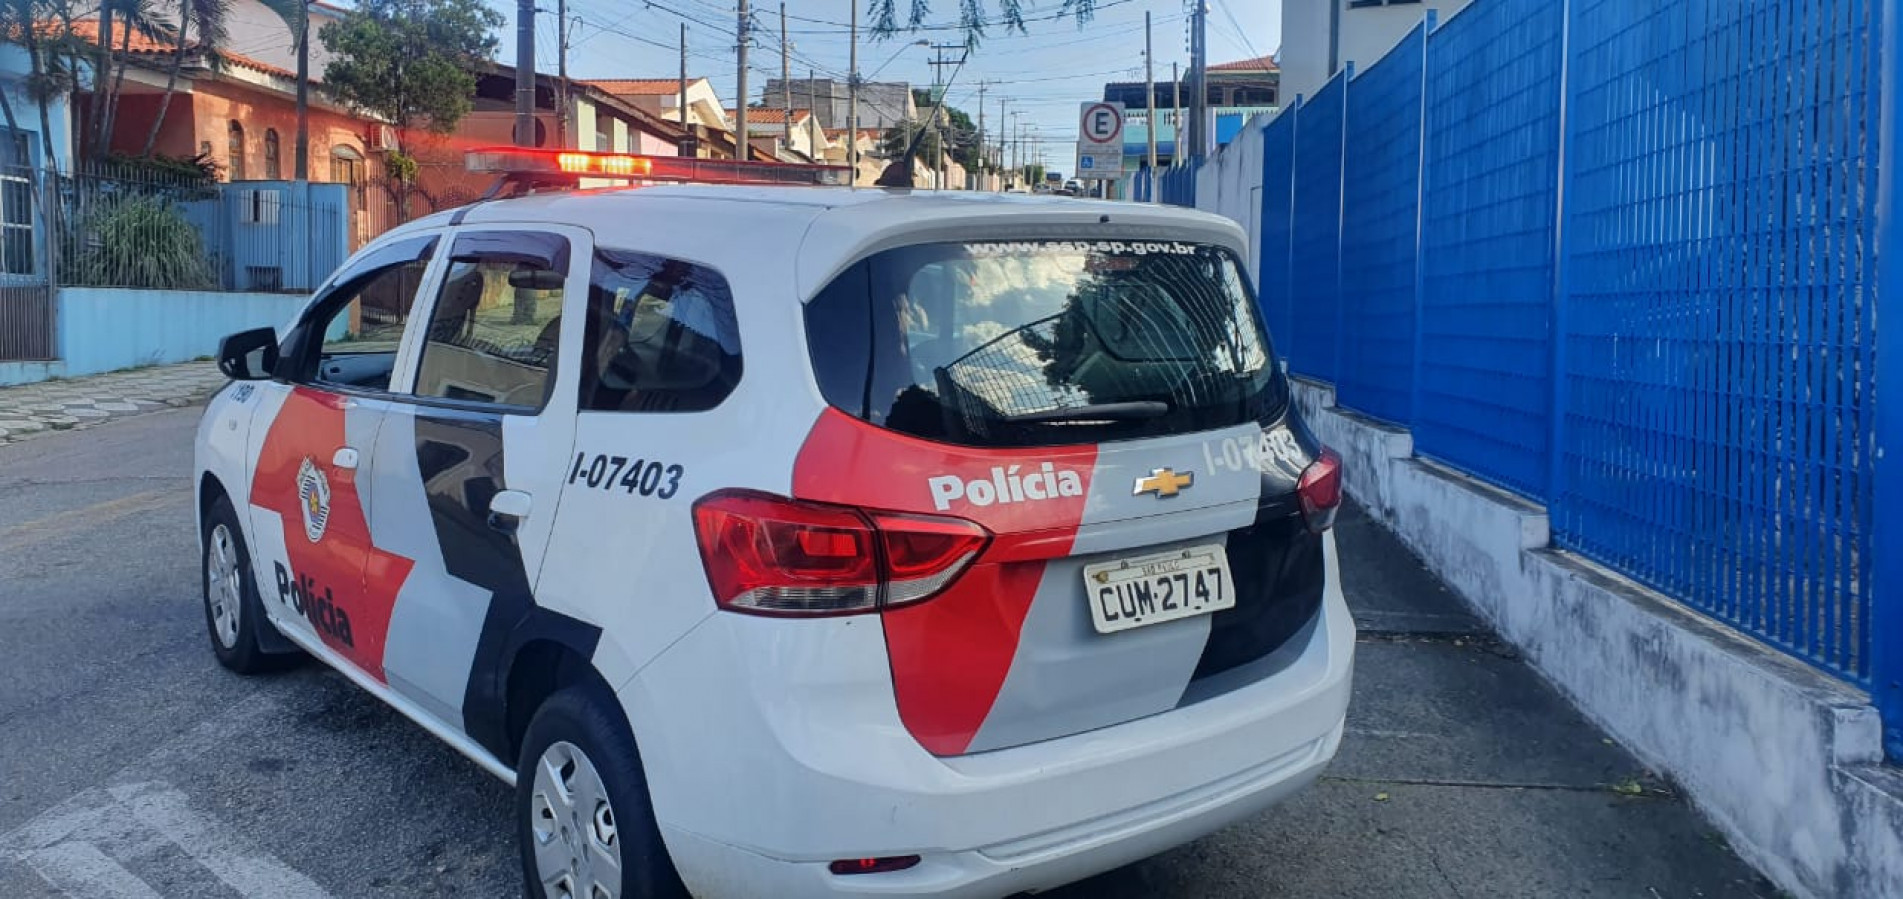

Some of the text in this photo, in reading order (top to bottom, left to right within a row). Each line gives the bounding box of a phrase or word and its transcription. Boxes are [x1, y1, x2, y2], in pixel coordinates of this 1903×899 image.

[1095, 112, 1109, 134] E
[963, 241, 1196, 255] www.ssp.sp.gov.br
[568, 451, 684, 500] I-07403
[1202, 428, 1301, 476] I-07403
[928, 461, 1083, 511] Polícia
[273, 559, 354, 648] Polícia
